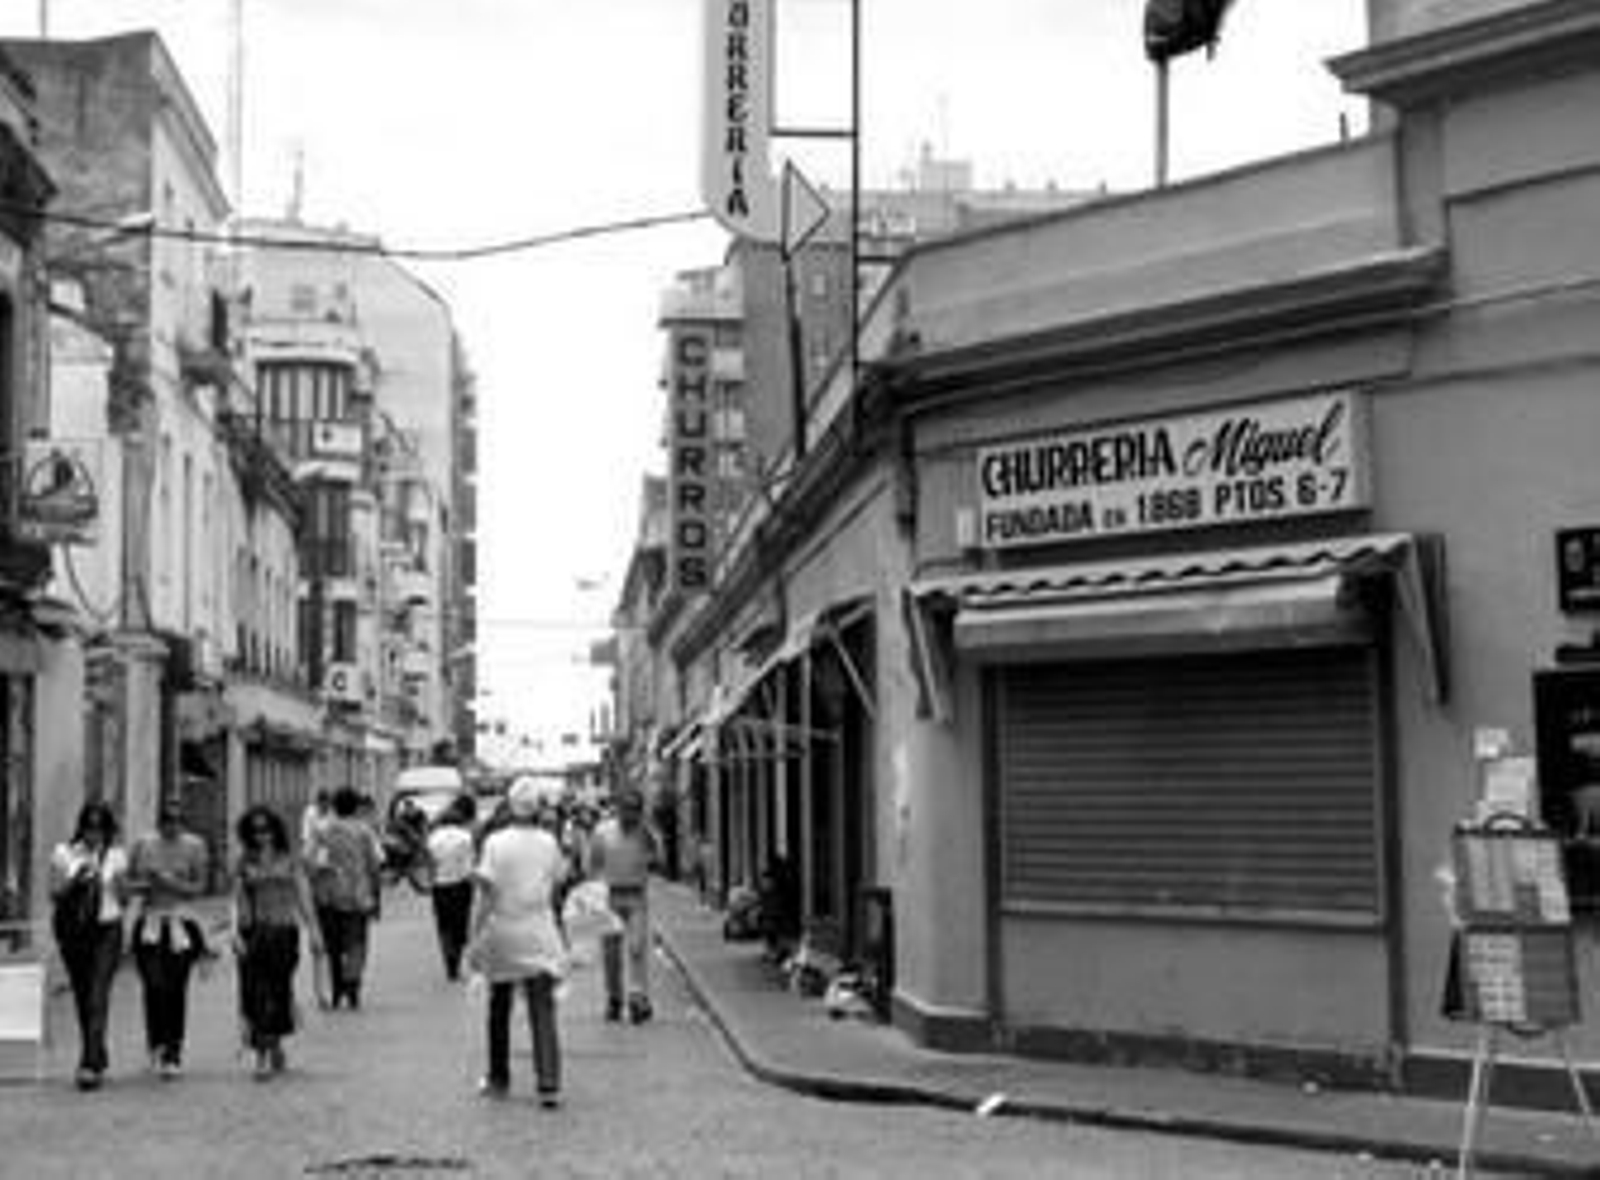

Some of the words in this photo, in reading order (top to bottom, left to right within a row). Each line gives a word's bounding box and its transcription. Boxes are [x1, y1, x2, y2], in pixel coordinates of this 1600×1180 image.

[679, 336, 706, 587] CHURROS
[981, 428, 1176, 499] CHURRERIA
[1184, 401, 1343, 478] Miguel
[986, 502, 1094, 541] FUNDADA
